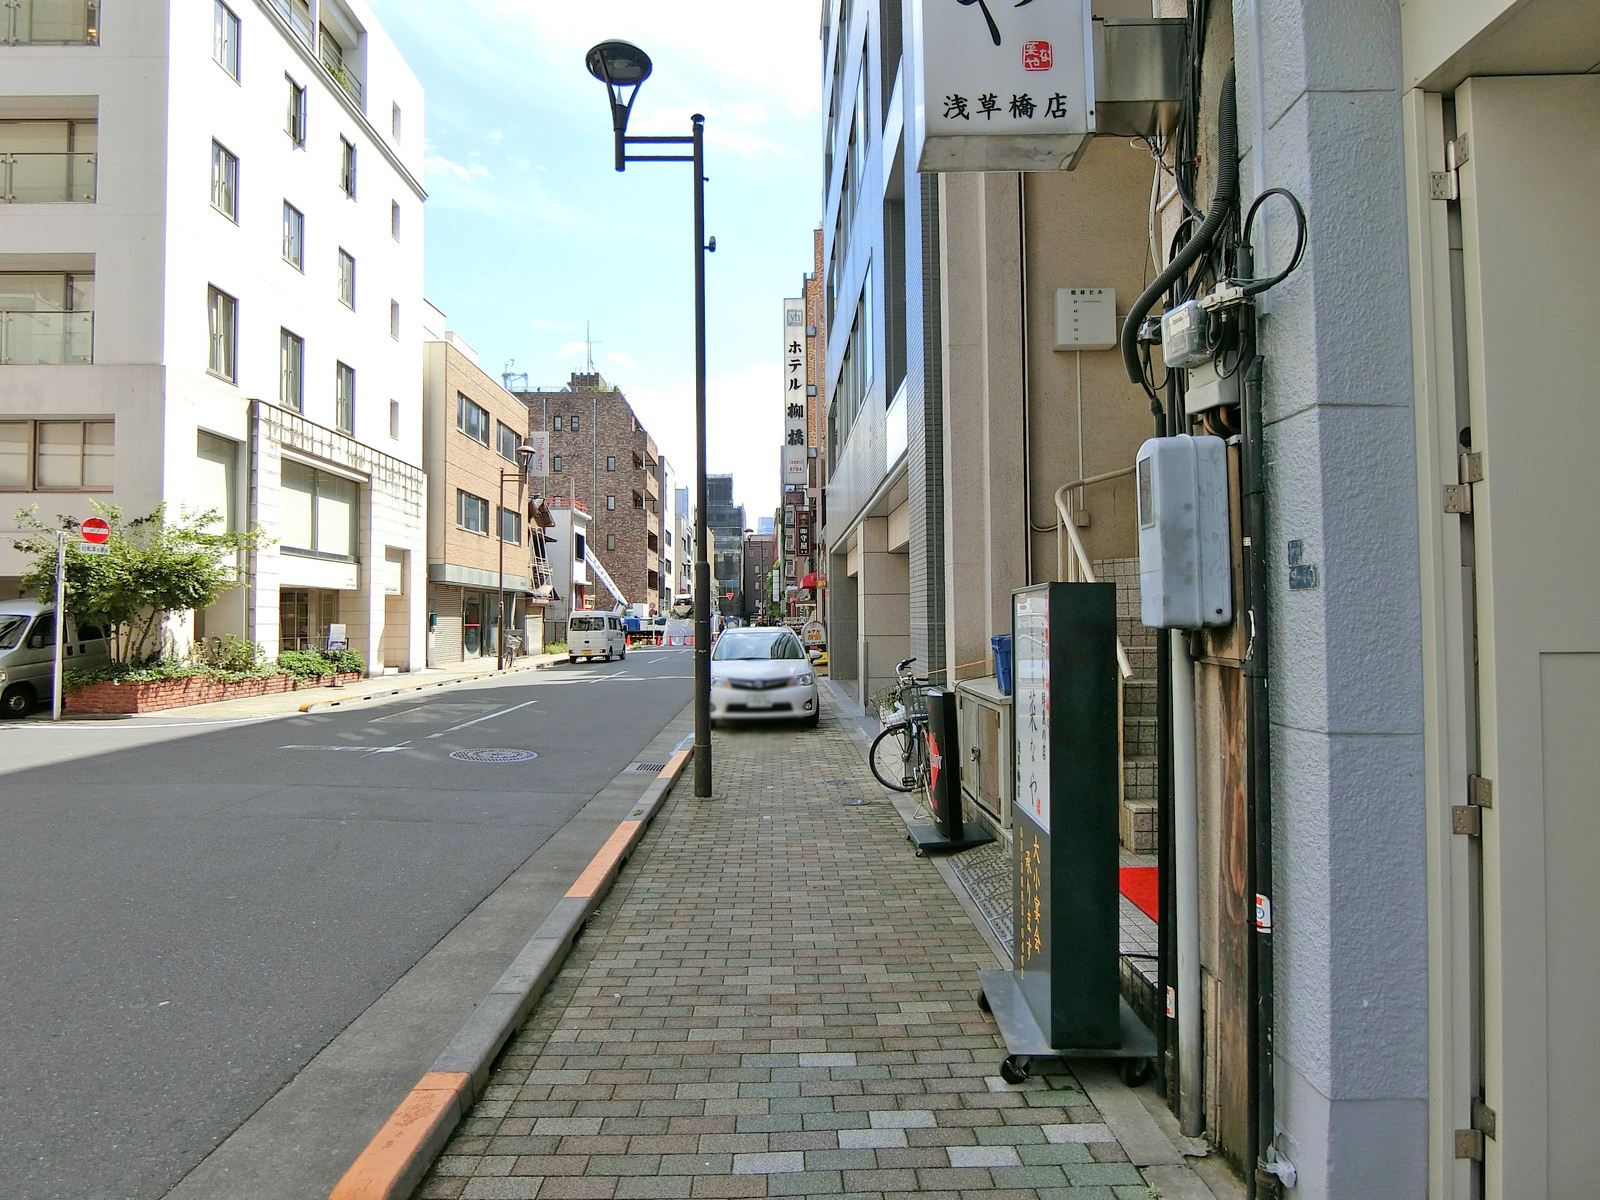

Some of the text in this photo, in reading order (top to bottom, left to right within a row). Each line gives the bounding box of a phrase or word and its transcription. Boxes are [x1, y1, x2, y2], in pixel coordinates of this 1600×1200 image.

[943, 92, 1068, 120] 浅草橋店
[1028, 690, 1038, 807] 菜なや
